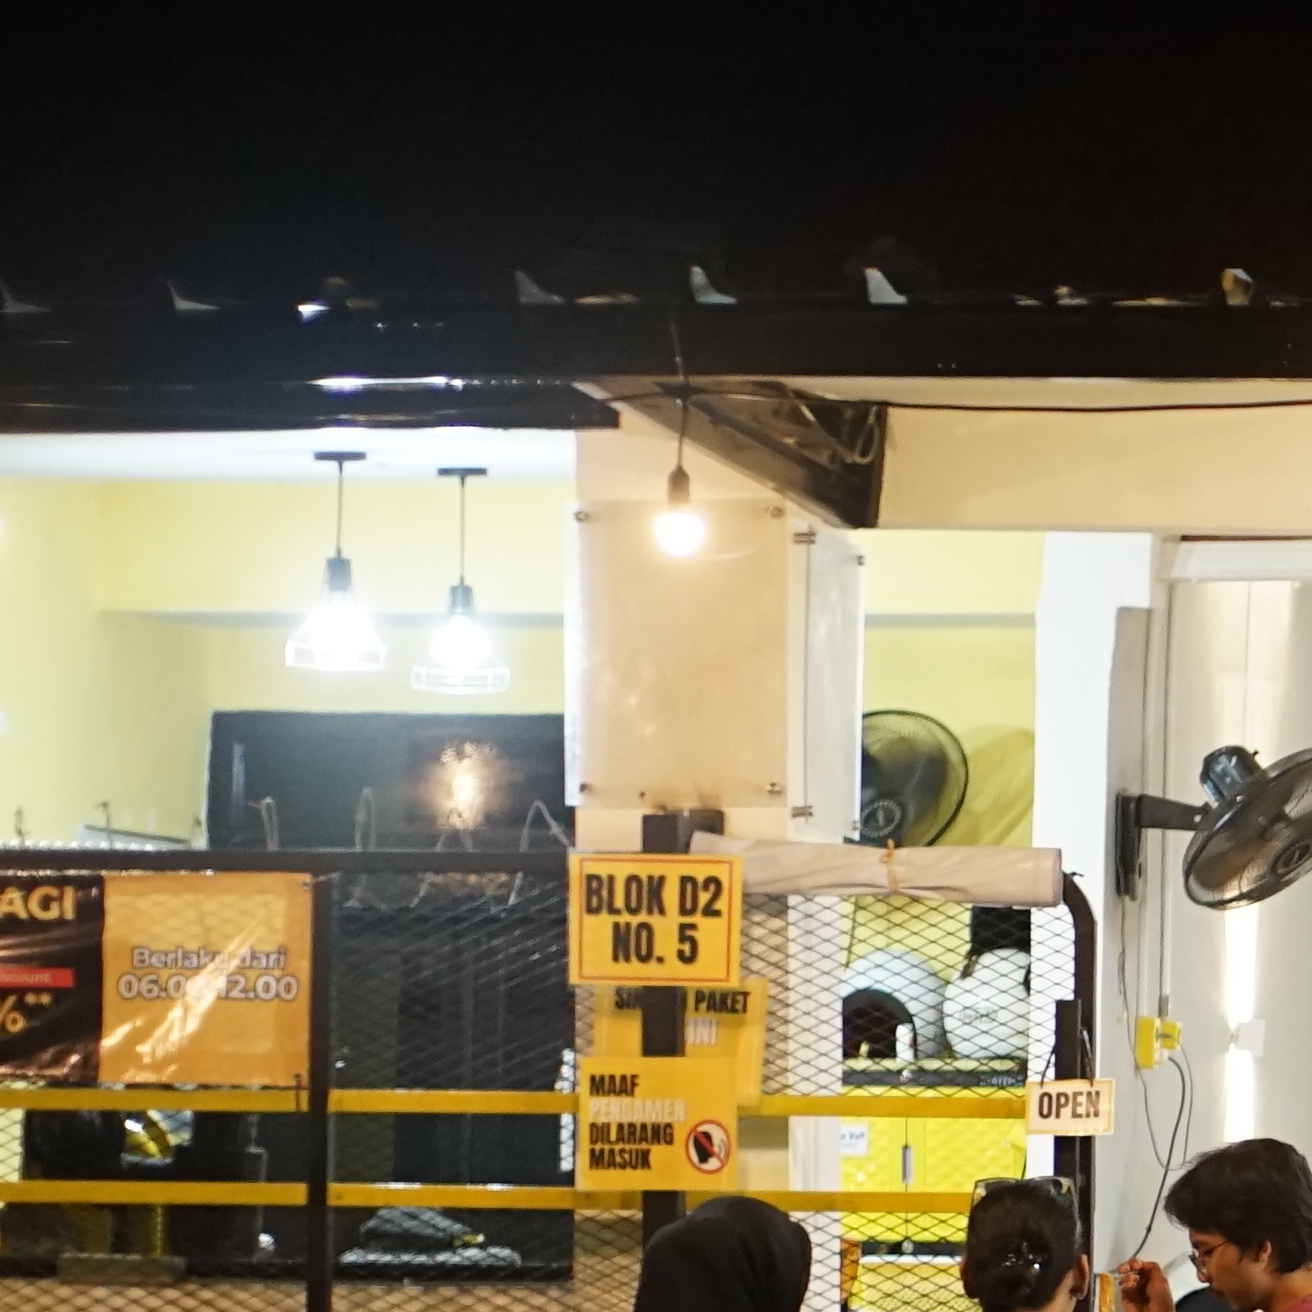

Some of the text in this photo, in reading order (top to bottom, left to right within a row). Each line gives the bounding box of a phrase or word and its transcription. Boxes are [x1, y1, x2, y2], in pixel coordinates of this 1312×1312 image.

[0, 884, 76, 921] AGI
[585, 873, 723, 918] BLOK D2
[612, 921, 699, 965] NO. 5
[237, 945, 287, 970] dari
[117, 973, 299, 1001] 06.012.00
[694, 989, 752, 1014] PAKET
[589, 1073, 640, 1097] MAAF
[1038, 1090, 1101, 1120] OPEN
[589, 1122, 674, 1146] DILARANG
[589, 1147, 652, 1171] MASUK
